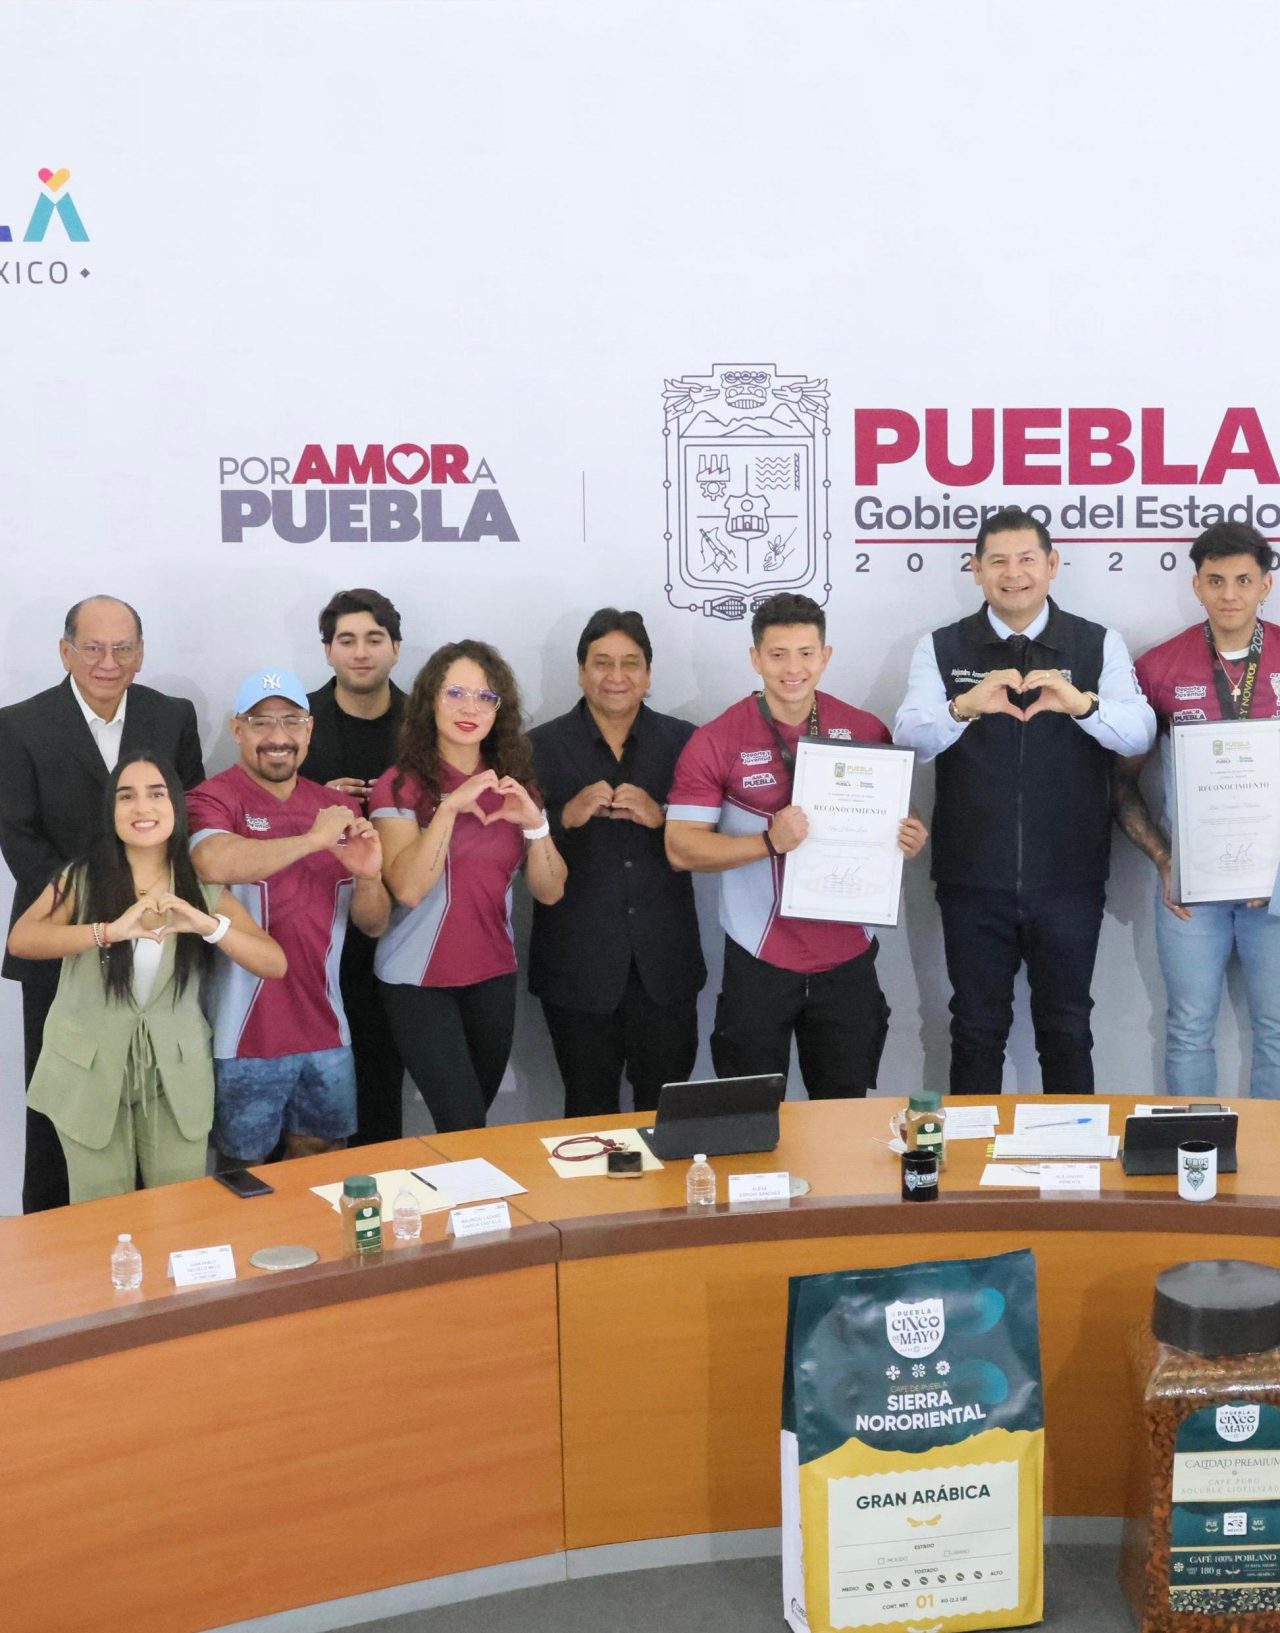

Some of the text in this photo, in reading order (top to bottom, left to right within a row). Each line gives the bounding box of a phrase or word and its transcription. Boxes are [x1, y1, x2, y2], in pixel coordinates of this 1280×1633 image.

[0, 168, 91, 242] A
[219, 443, 497, 485] POR AMOR A
[221, 488, 520, 544] PUEBLA
[1060, 495, 1123, 531] del
[263, 674, 281, 691] NY
[1243, 663, 1257, 706] NOVATOS
[1175, 713, 1205, 721] PUEBLA
[744, 778, 775, 787] PUEBLA
[1198, 782, 1270, 793] RECONOCIMIENTO
[814, 804, 887, 816] RECONOCIMIENTO
[897, 1309, 933, 1317] PUEBLA
[891, 1316, 940, 1331] CINCO
[899, 1330, 940, 1345] MAYO
[887, 1390, 953, 1411] SIERRA
[856, 1403, 987, 1431] NORORIENTAL
[1219, 1415, 1256, 1424] CINCO
[1224, 1424, 1254, 1433] MAYO
[1185, 1459, 1233, 1470] CALIDAD
[856, 1484, 991, 1510] GRAN ARÁBICA
[1189, 1554, 1213, 1564] CAFÉ
[1234, 1553, 1277, 1563] POBLANO
[1200, 1567, 1215, 1575] 180
[916, 1594, 934, 1609] 01
